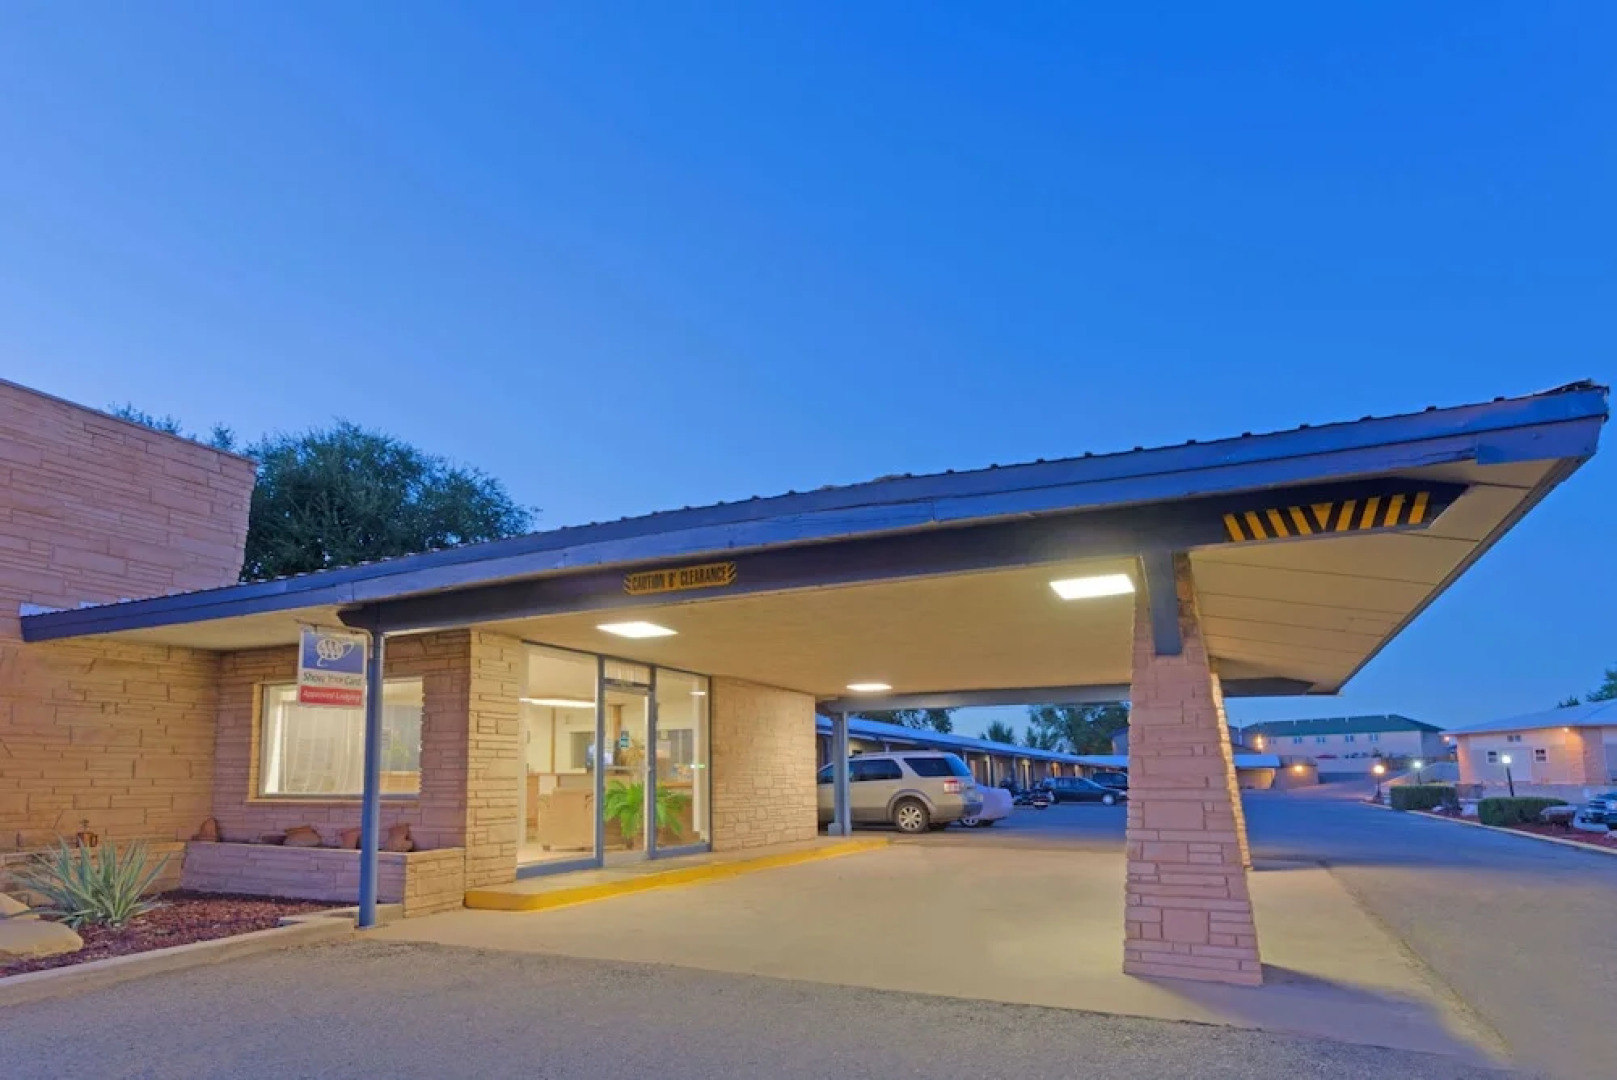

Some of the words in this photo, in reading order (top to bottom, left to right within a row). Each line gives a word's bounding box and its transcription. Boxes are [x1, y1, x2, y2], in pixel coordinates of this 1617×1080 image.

[632, 573, 666, 591] CAUTION
[681, 565, 727, 586] CLEARANCE
[303, 672, 324, 683] Show
[344, 675, 361, 685] Card
[303, 687, 335, 699] Approved
[336, 690, 360, 702] Lodging
